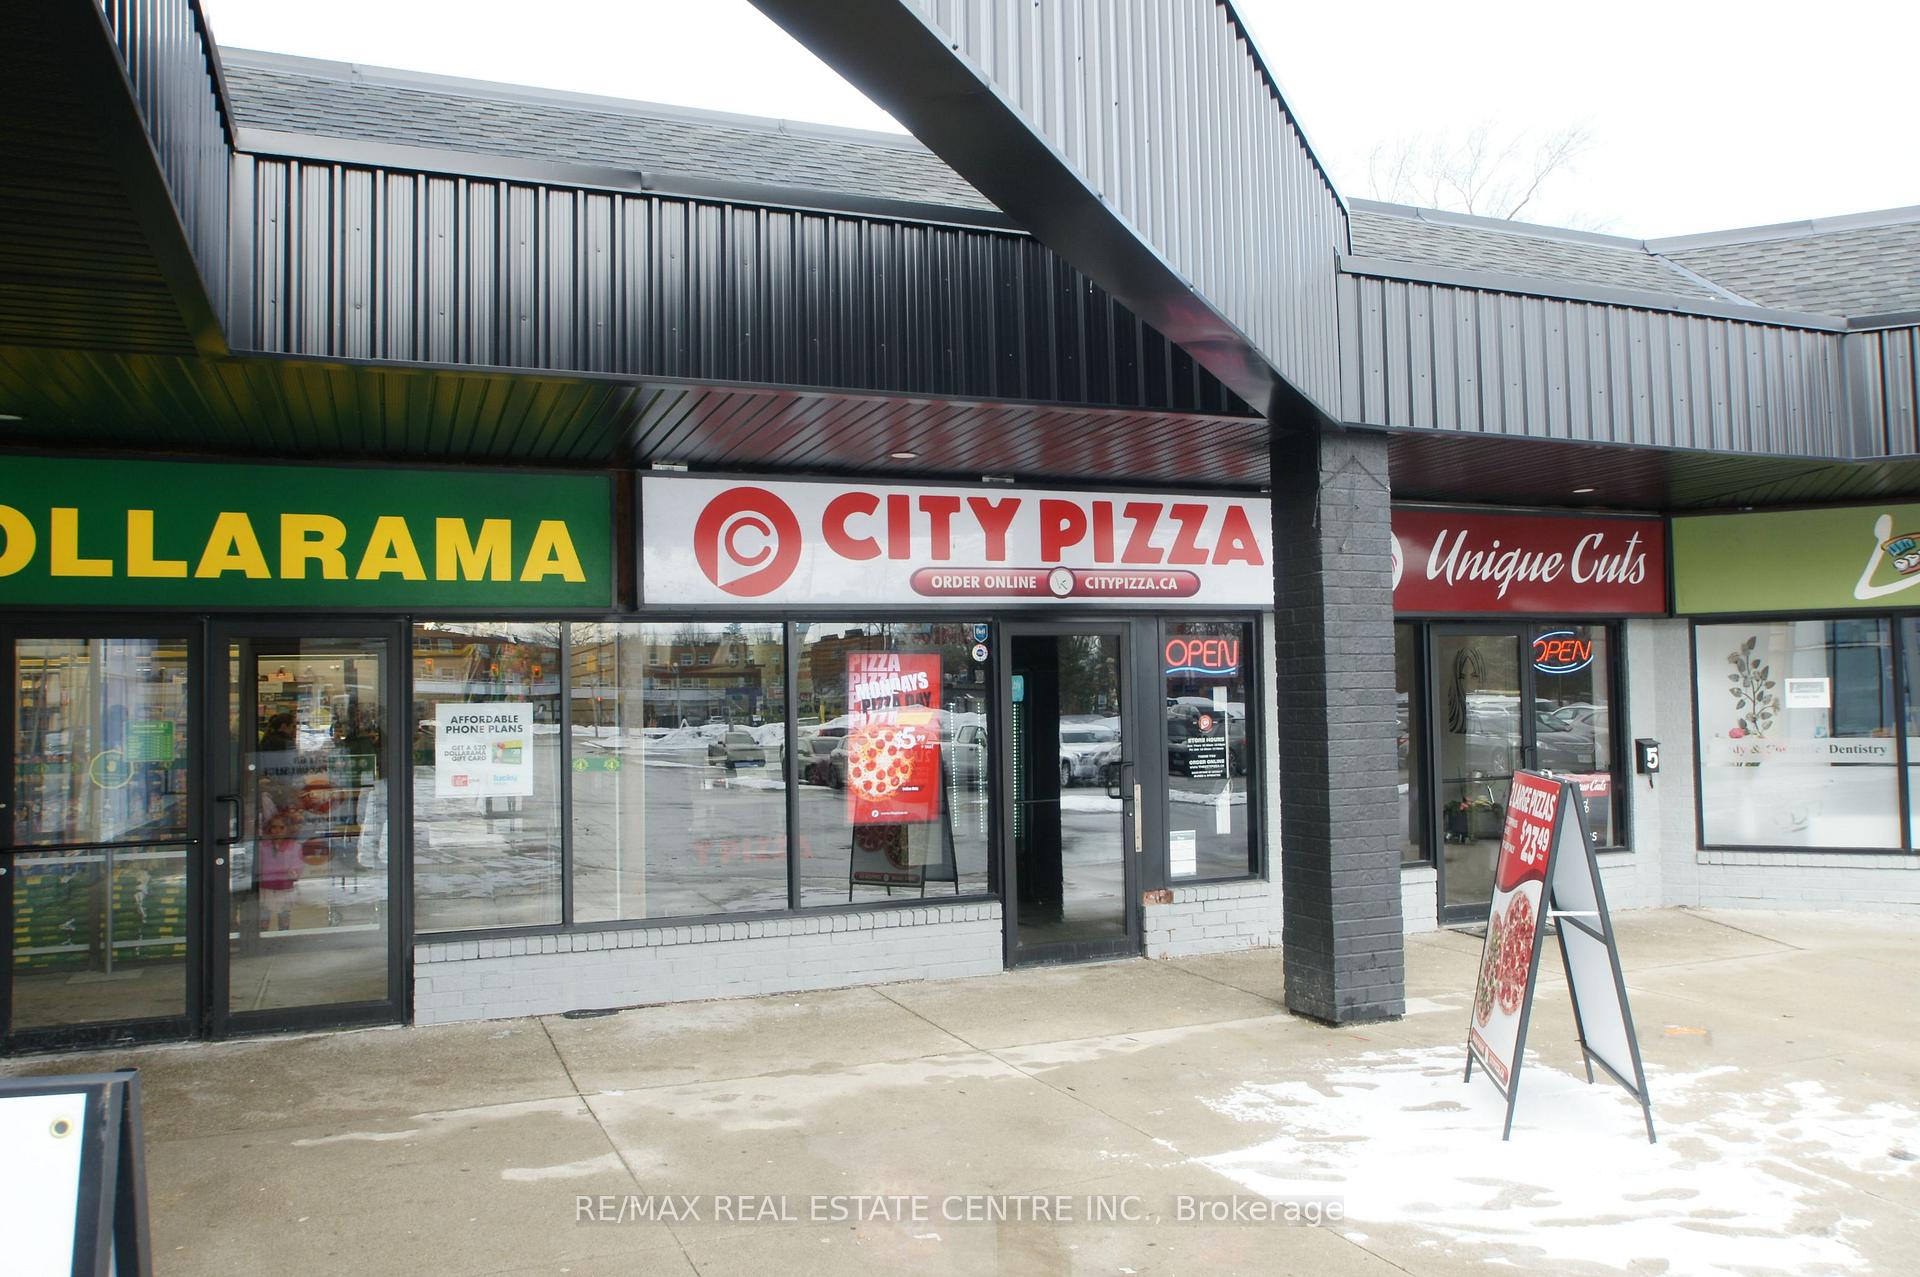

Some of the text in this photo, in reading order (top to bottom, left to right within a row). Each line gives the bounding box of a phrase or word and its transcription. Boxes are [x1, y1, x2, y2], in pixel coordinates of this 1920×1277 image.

[822, 492, 1265, 565] CITY PIZZA
[1426, 529, 1647, 600] Unique Cuts
[931, 575, 1037, 589] ORDER ONLINE
[1084, 576, 1178, 590] CITYPIZZA.CA
[1165, 639, 1239, 667] OPEN
[1533, 640, 1592, 662] OPEN
[848, 653, 901, 672] PIZZA
[855, 671, 929, 700] MONDAYS
[445, 724, 523, 734] PHONE PLANS
[450, 715, 519, 724] AFFORDABLE
[1646, 746, 1658, 769] 5
[1829, 744, 1887, 757] Dentistry
[1512, 783, 1534, 814] LARGE
[1528, 788, 1557, 823] PIZZAS
